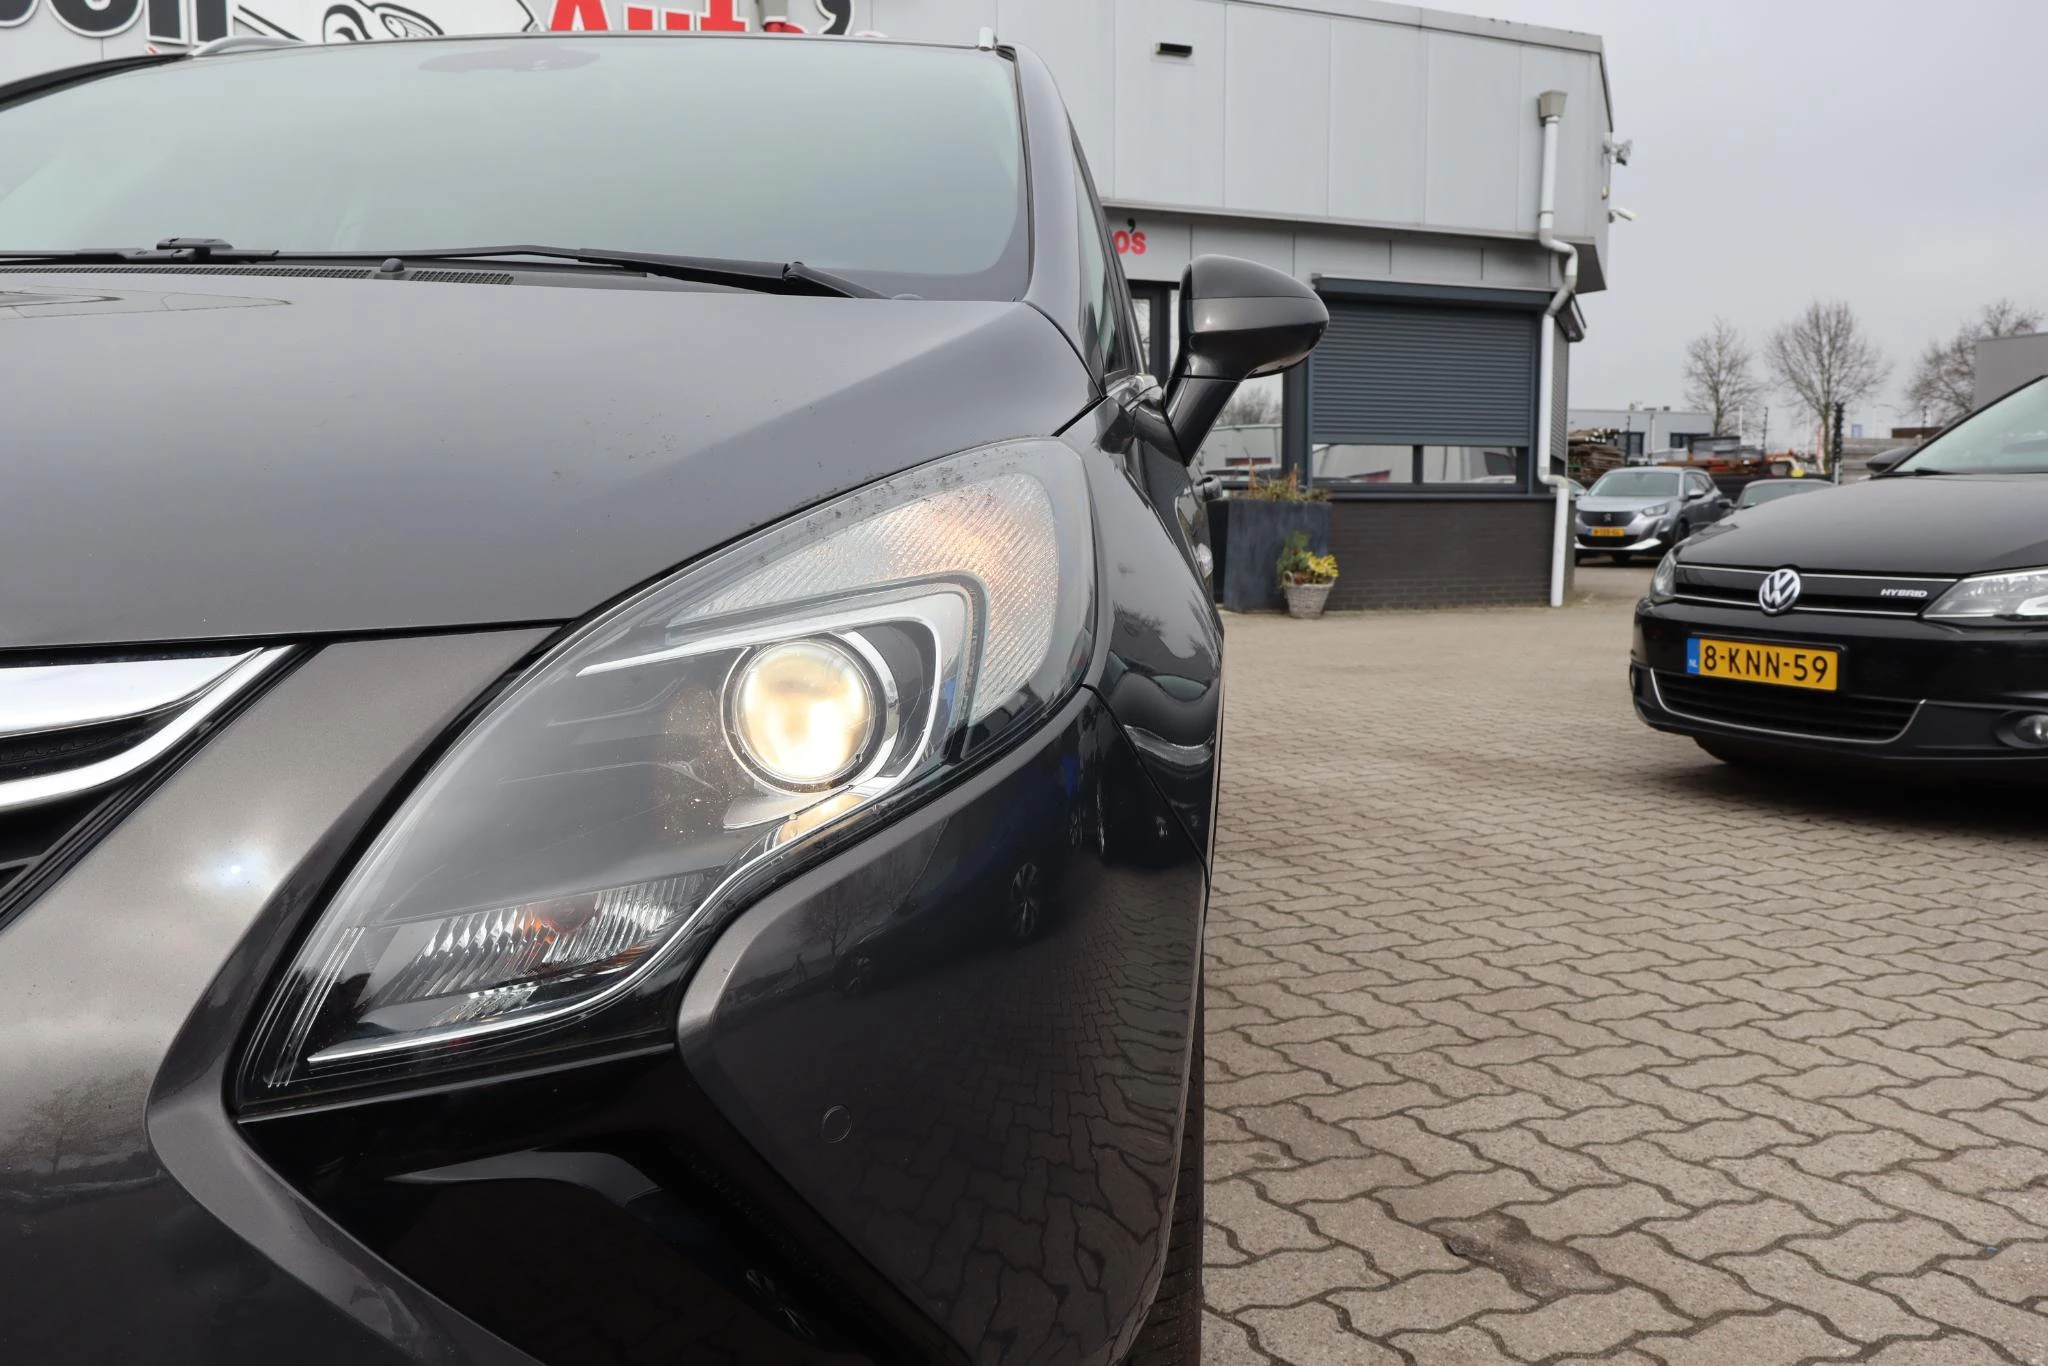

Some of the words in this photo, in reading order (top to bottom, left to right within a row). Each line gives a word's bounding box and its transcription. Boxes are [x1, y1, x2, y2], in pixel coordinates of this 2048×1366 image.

[1113, 217, 1147, 255] o's
[1880, 588, 1928, 598] HYBRID
[1688, 658, 1698, 668] NL
[1704, 645, 1828, 683] 8-KNN-59
